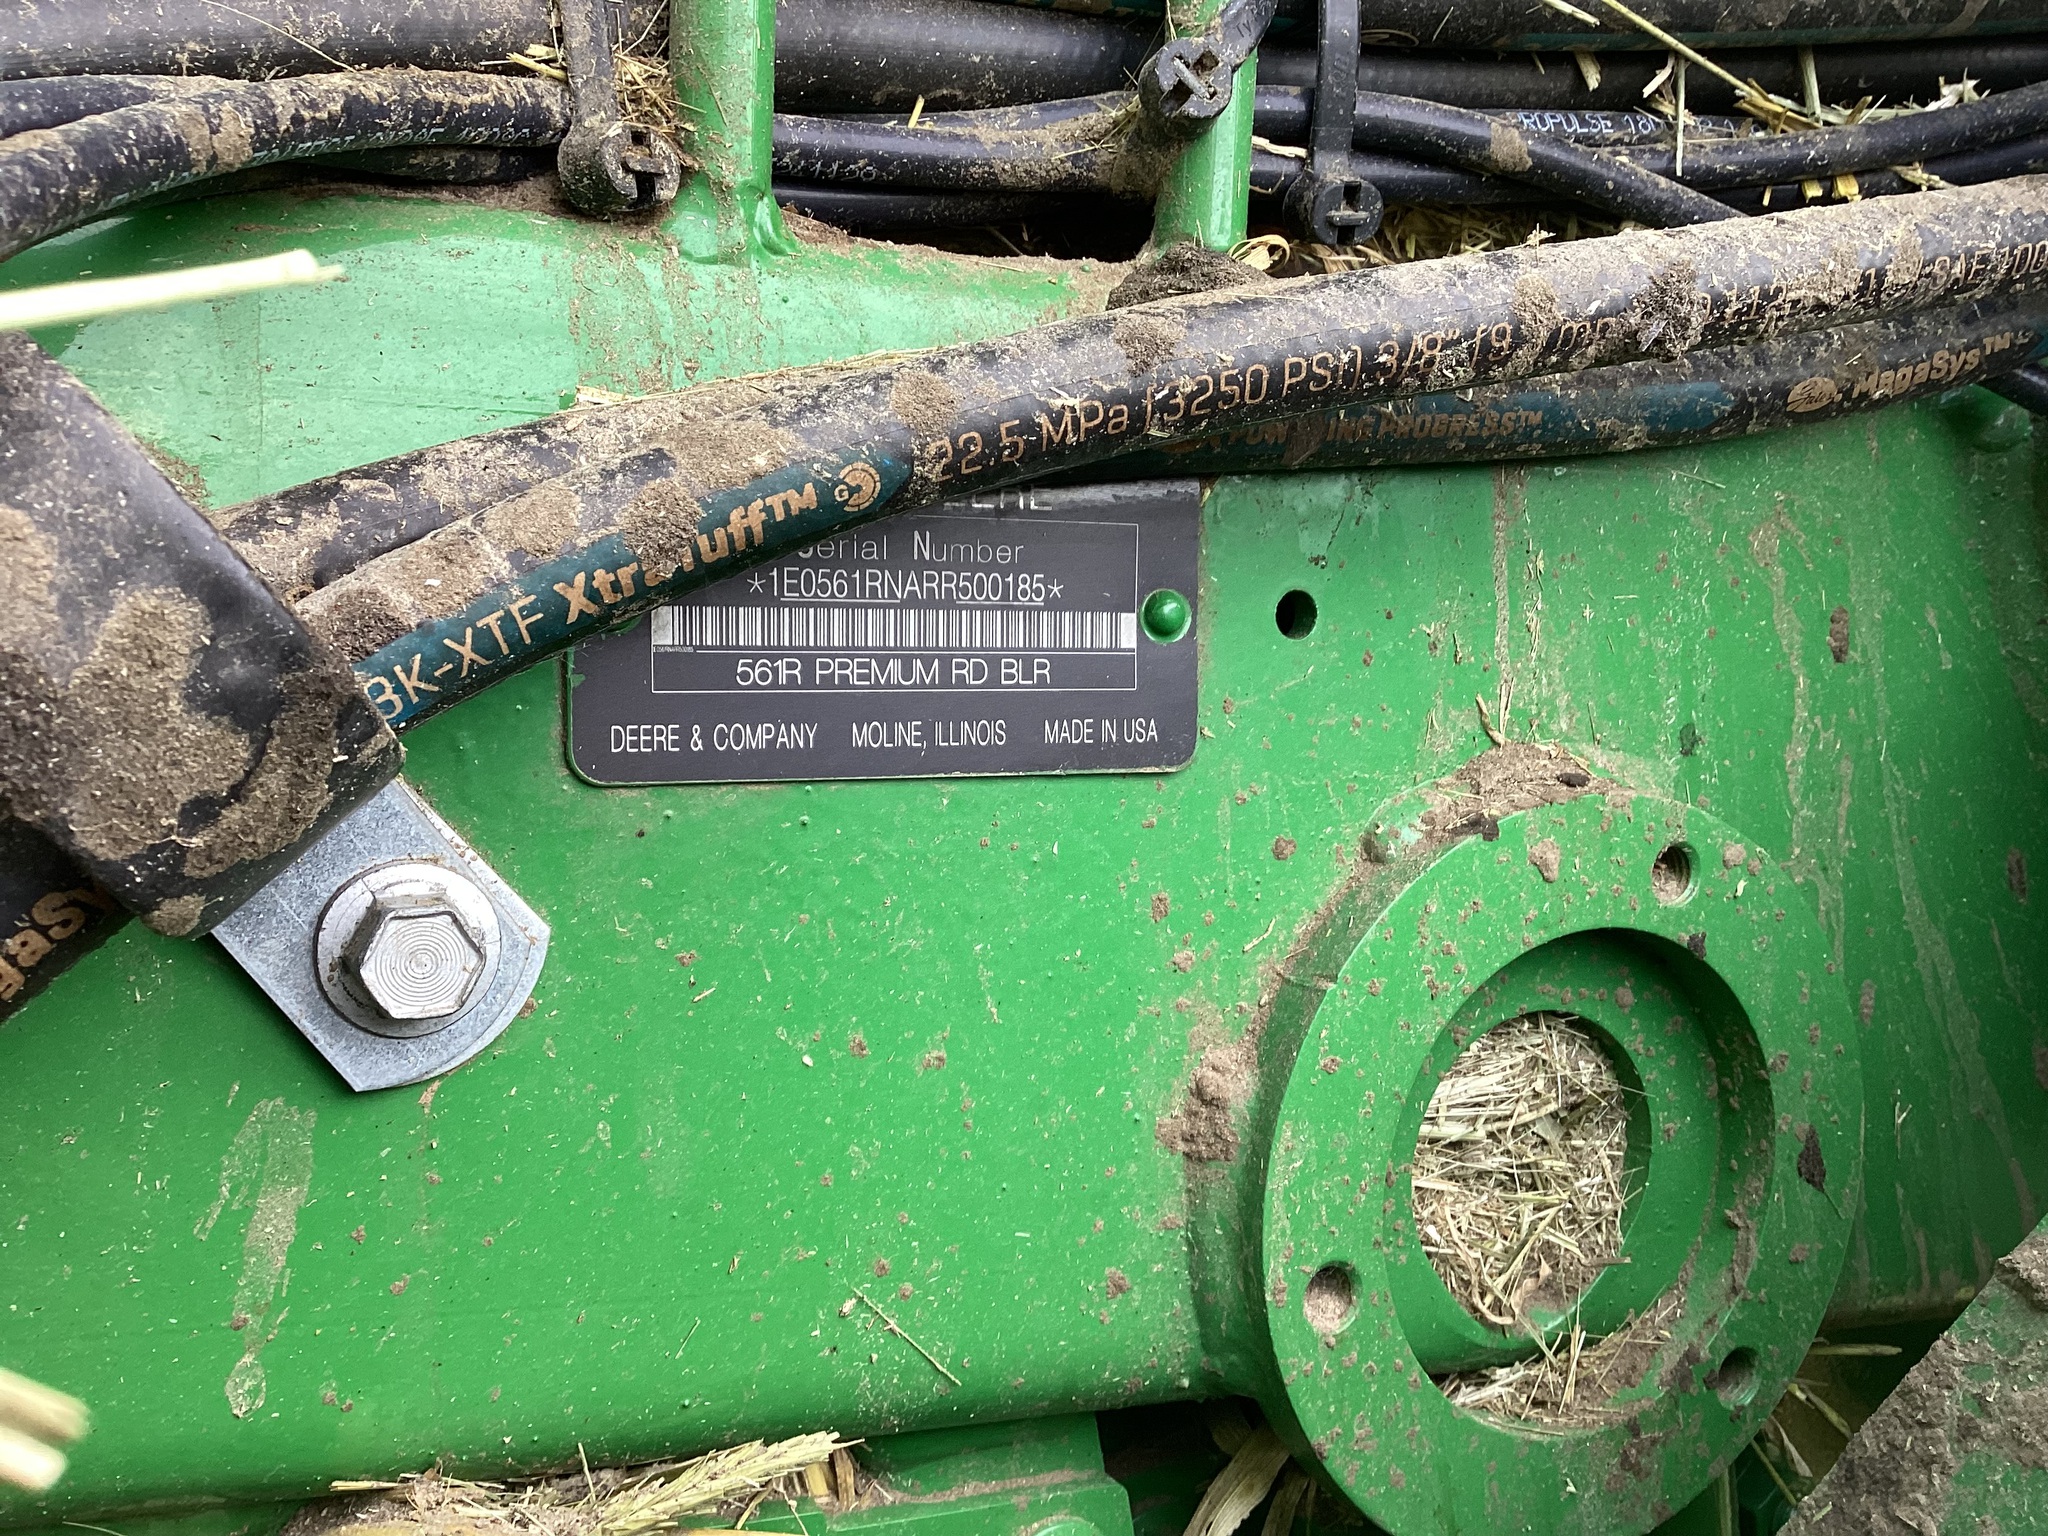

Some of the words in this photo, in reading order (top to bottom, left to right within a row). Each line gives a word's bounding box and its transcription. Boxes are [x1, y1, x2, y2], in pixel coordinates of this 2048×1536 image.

[1040, 399, 1129, 451] MPa
[913, 530, 1024, 564] Number
[736, 657, 802, 687] 561R
[816, 657, 939, 686] PREMIUM
[951, 657, 989, 686] RD
[1001, 657, 1051, 686] BLR
[611, 724, 680, 753] DEERE
[690, 724, 704, 752] &
[713, 722, 818, 752] COMPANY
[852, 720, 927, 750] MOLINE,
[934, 719, 1007, 747] ILLINOIS
[1044, 718, 1094, 745] MADE
[1101, 718, 1117, 744] IN
[1123, 717, 1159, 744] USA
